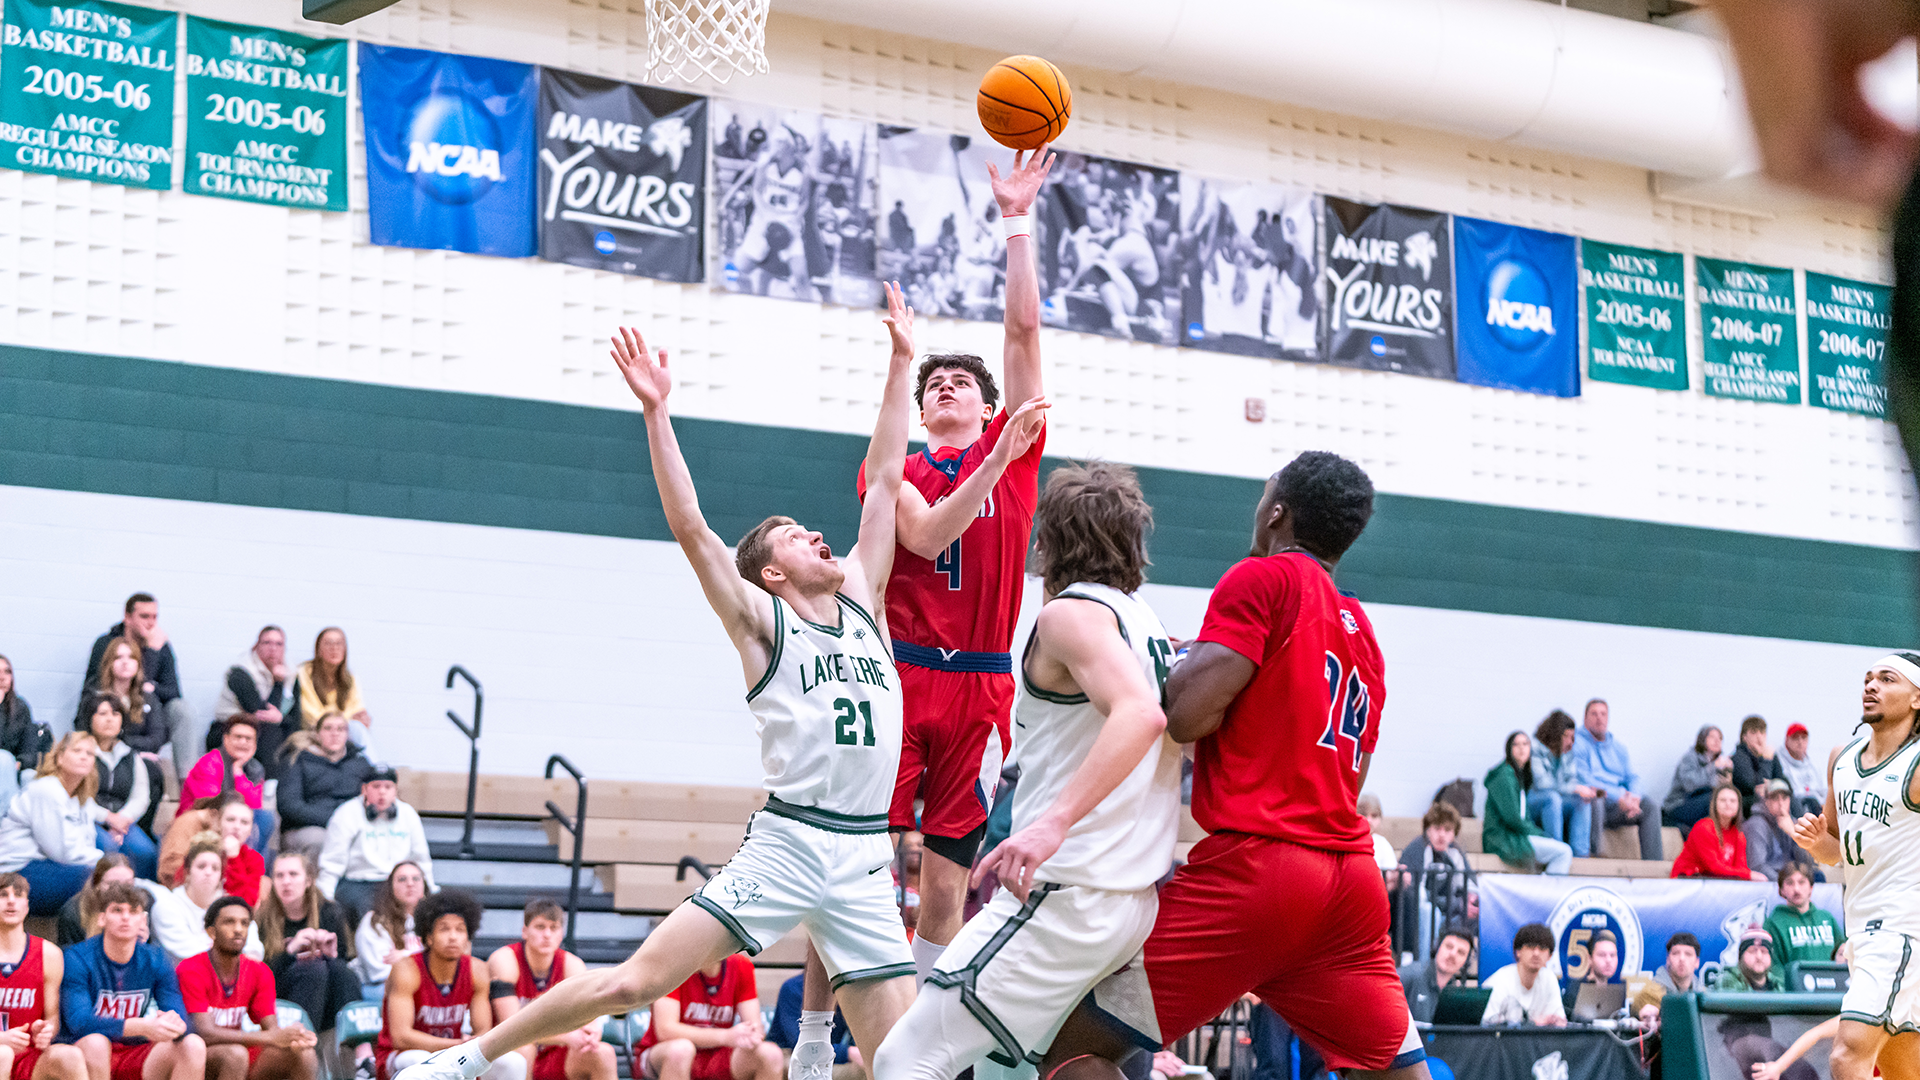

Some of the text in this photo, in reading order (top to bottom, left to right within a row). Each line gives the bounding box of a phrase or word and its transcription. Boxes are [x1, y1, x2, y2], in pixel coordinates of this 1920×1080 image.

[50, 6, 132, 38] MEN'S
[4, 24, 174, 71] BASKETBALL
[230, 35, 306, 67] MEN'S
[22, 65, 151, 111] 2005-06
[187, 54, 347, 97] BASKETBALL
[51, 113, 120, 138] AMCC
[205, 93, 326, 136] 2005-06
[0, 121, 172, 164] REGULAR SEASON
[547, 111, 643, 152] MAKE
[16, 146, 150, 182] CHAMPIONS
[233, 140, 299, 163] AMCC
[406, 142, 502, 181] NCAA
[196, 152, 332, 185] TOURNAMENT
[200, 172, 328, 206] CHAMPIONS
[540, 145, 695, 227] YOURS
[1331, 233, 1400, 267] MAKE
[1608, 253, 1658, 277] MEN'S
[1327, 262, 1442, 331] YOURS
[1582, 268, 1684, 301] BASKETBALL
[1724, 269, 1769, 292] MEN'S
[1831, 284, 1874, 308] MEN'S
[1487, 298, 1553, 334] NCAA
[1596, 299, 1672, 332] 2005-06
[1698, 286, 1795, 315] BASKETBALL
[1617, 335, 1653, 355] NCAA
[1711, 316, 1783, 347] 2006-07
[1818, 329, 1885, 362] 2006-07
[1592, 347, 1677, 374] TOURNAMENT
[1704, 360, 1799, 386] REGULAR SEASON
[1729, 351, 1767, 367] AMCC
[1836, 364, 1871, 381] AMCC
[1713, 377, 1788, 400] CHAMPIONS
[1816, 374, 1889, 400] TOURNAMENT
[1822, 390, 1884, 414] CHAMPIONS
[935, 534, 962, 590] 4
[799, 653, 890, 694] LAKE ERIE
[833, 697, 876, 746] 21
[1862, 791, 1893, 828] ERIE
[1844, 829, 1865, 866] 11
